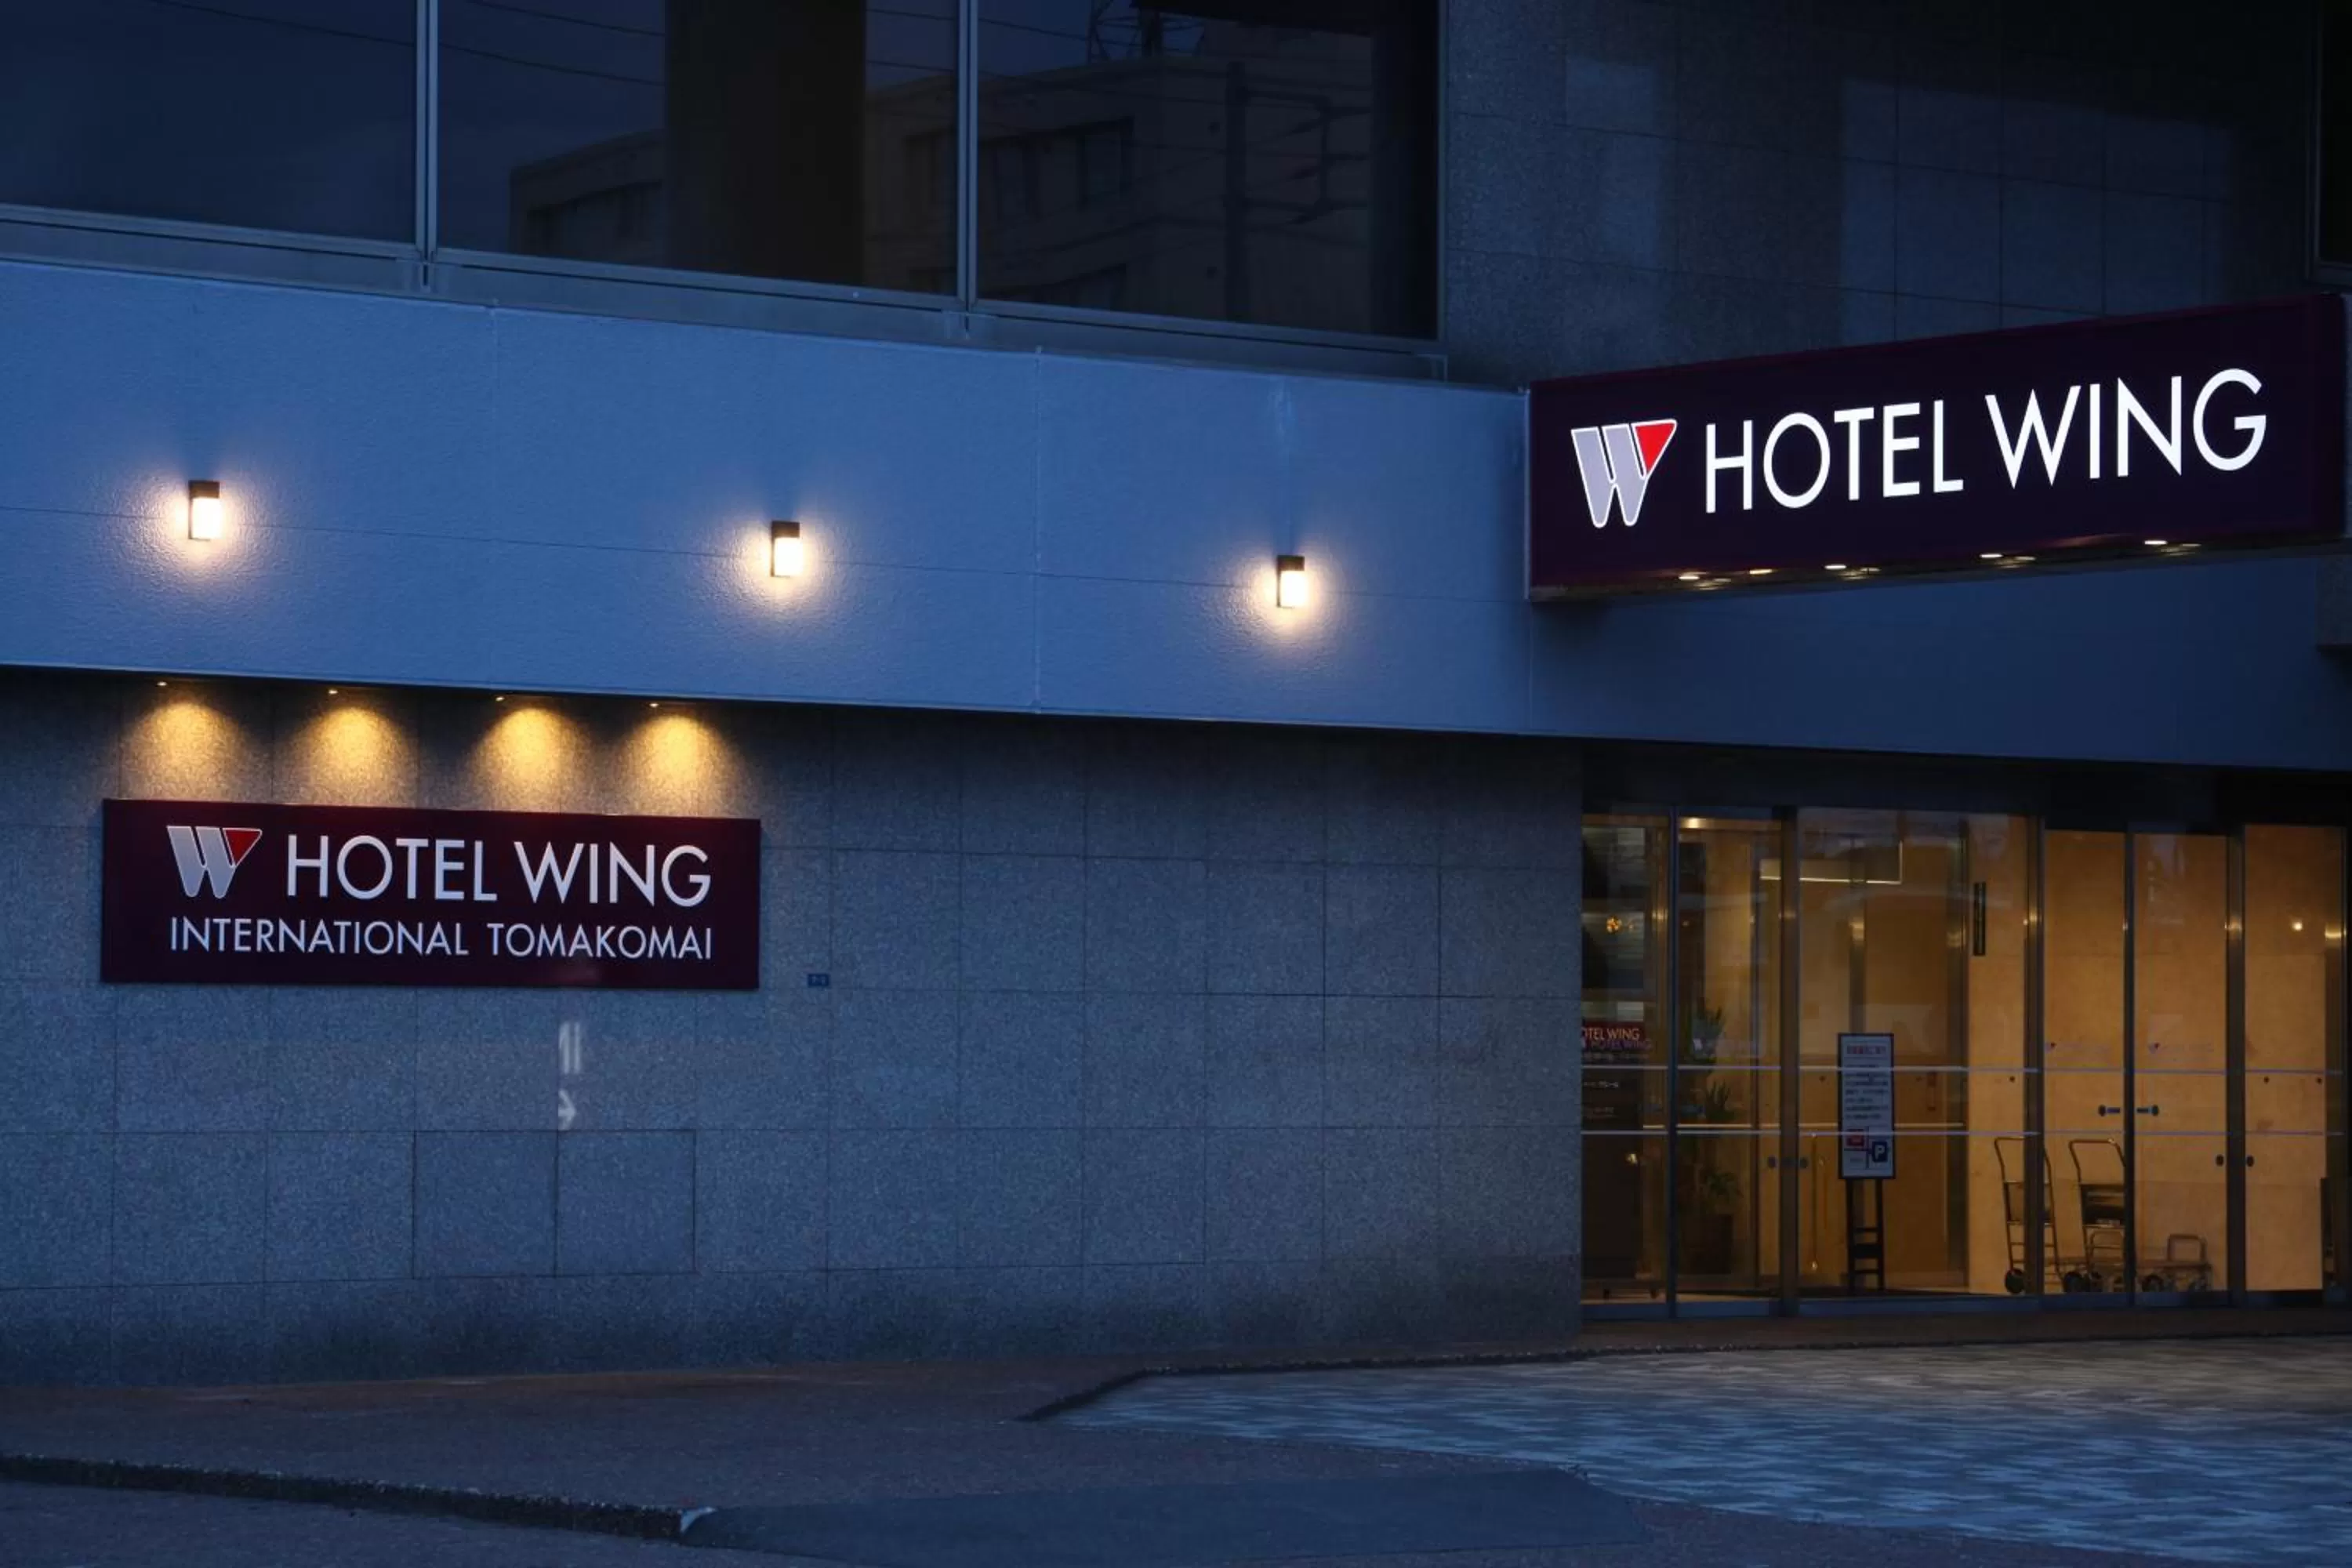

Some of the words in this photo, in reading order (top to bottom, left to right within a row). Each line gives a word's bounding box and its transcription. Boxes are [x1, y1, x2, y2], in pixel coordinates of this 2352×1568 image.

[1706, 400, 1963, 514] HOTEL
[1985, 368, 2267, 488] WING
[288, 835, 498, 901] HOTEL
[514, 842, 711, 907] WING
[171, 916, 469, 955] INTERNATIONAL
[486, 923, 711, 960] TOMAKOMAI
[1606, 1028, 1640, 1041] WING
